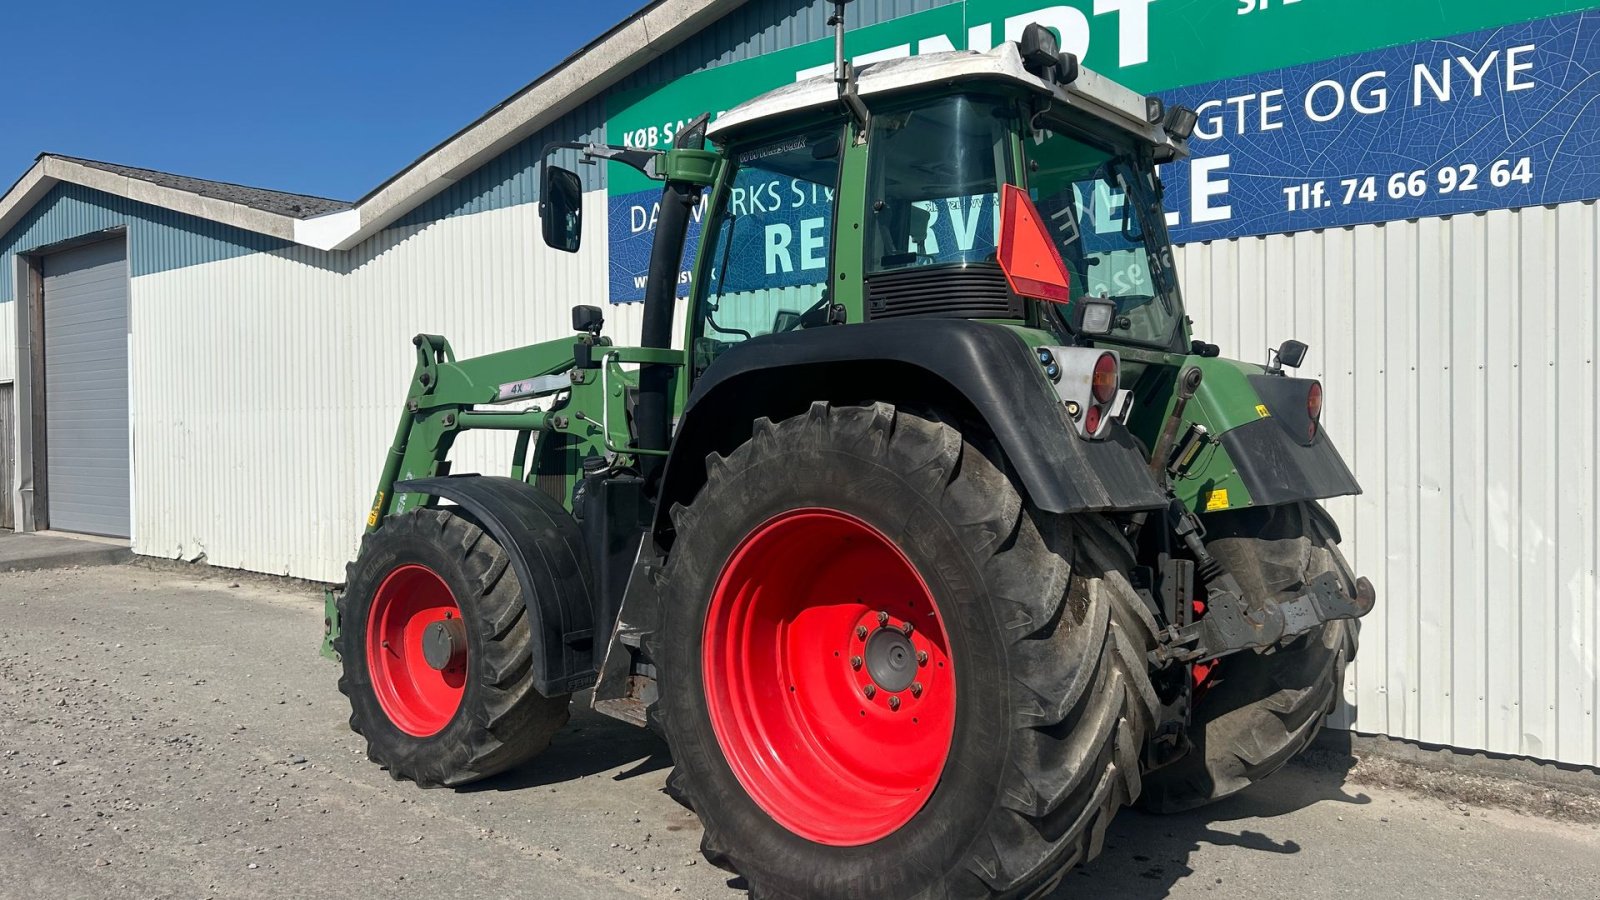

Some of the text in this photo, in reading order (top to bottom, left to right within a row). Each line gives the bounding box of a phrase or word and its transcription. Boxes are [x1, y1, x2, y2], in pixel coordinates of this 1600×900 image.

[1304, 71, 1387, 123] OG
[1413, 44, 1536, 107] NYE
[1283, 157, 1533, 212] Tlf. 74 66 92 64
